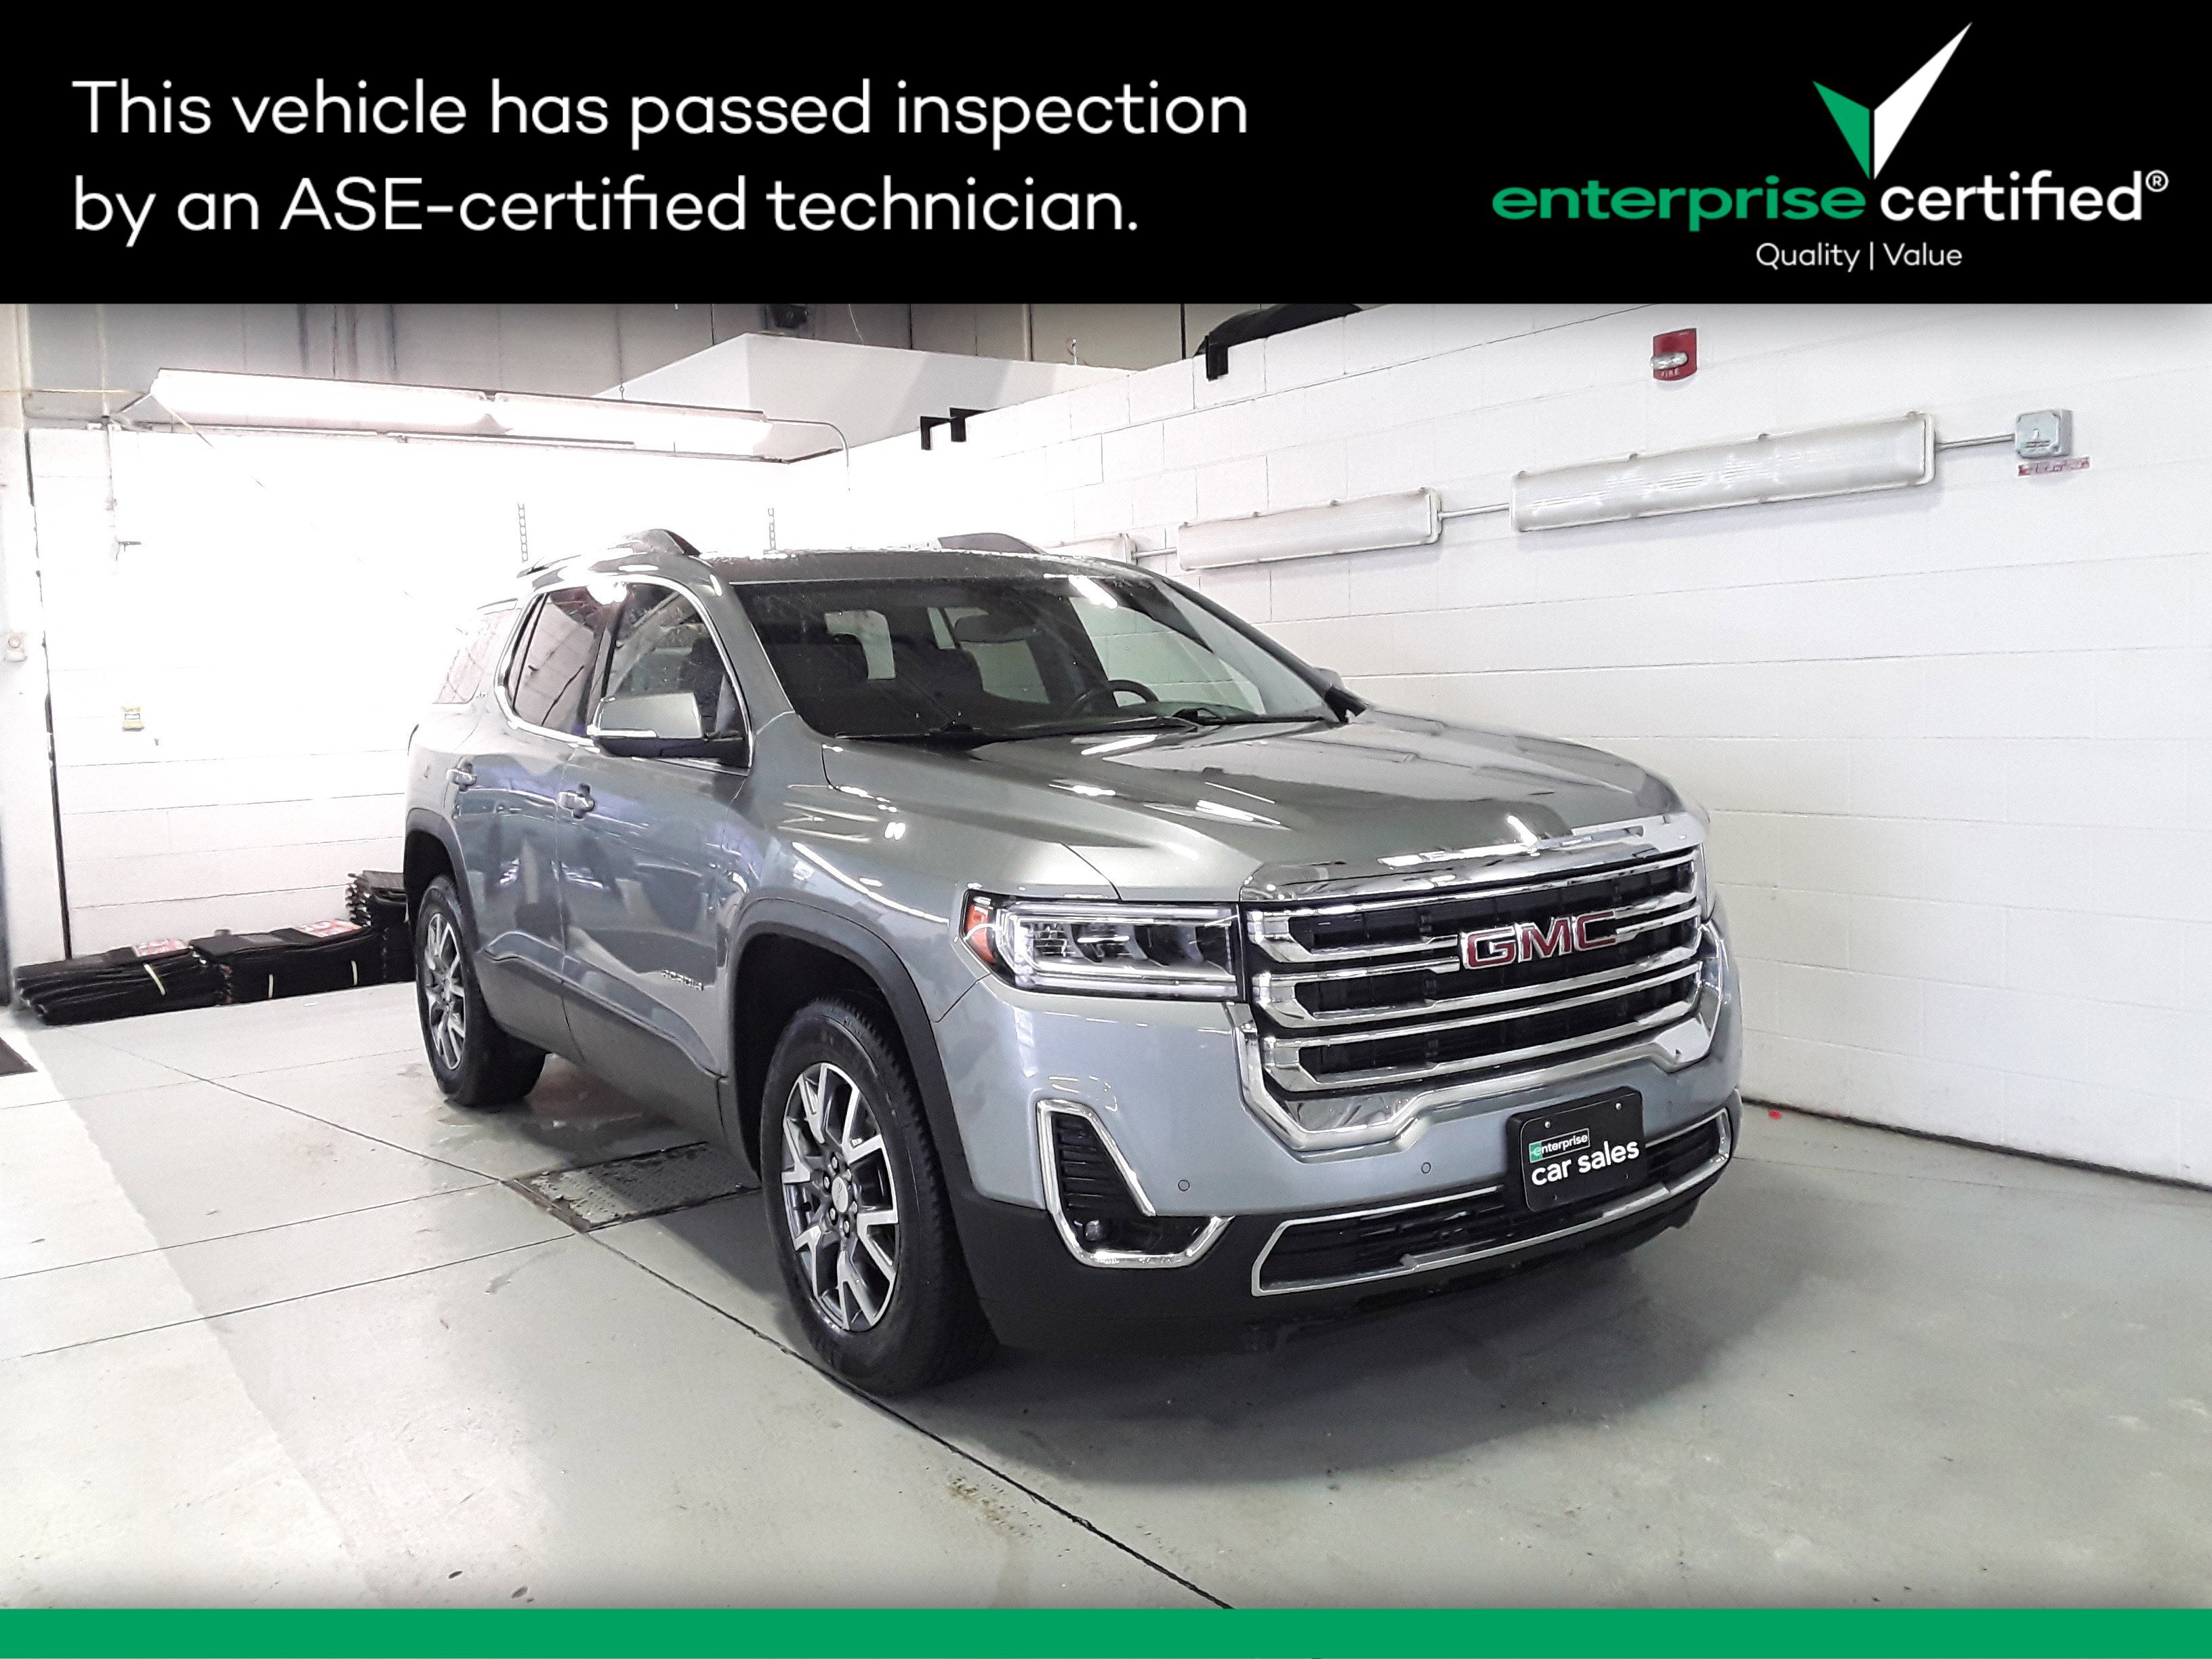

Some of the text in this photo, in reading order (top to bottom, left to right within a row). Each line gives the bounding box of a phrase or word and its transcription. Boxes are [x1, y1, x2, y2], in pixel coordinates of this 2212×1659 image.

[1460, 909, 1616, 969] GMC
[1531, 1134, 1589, 1157] enterprise
[1532, 1141, 1639, 1186] car sales
